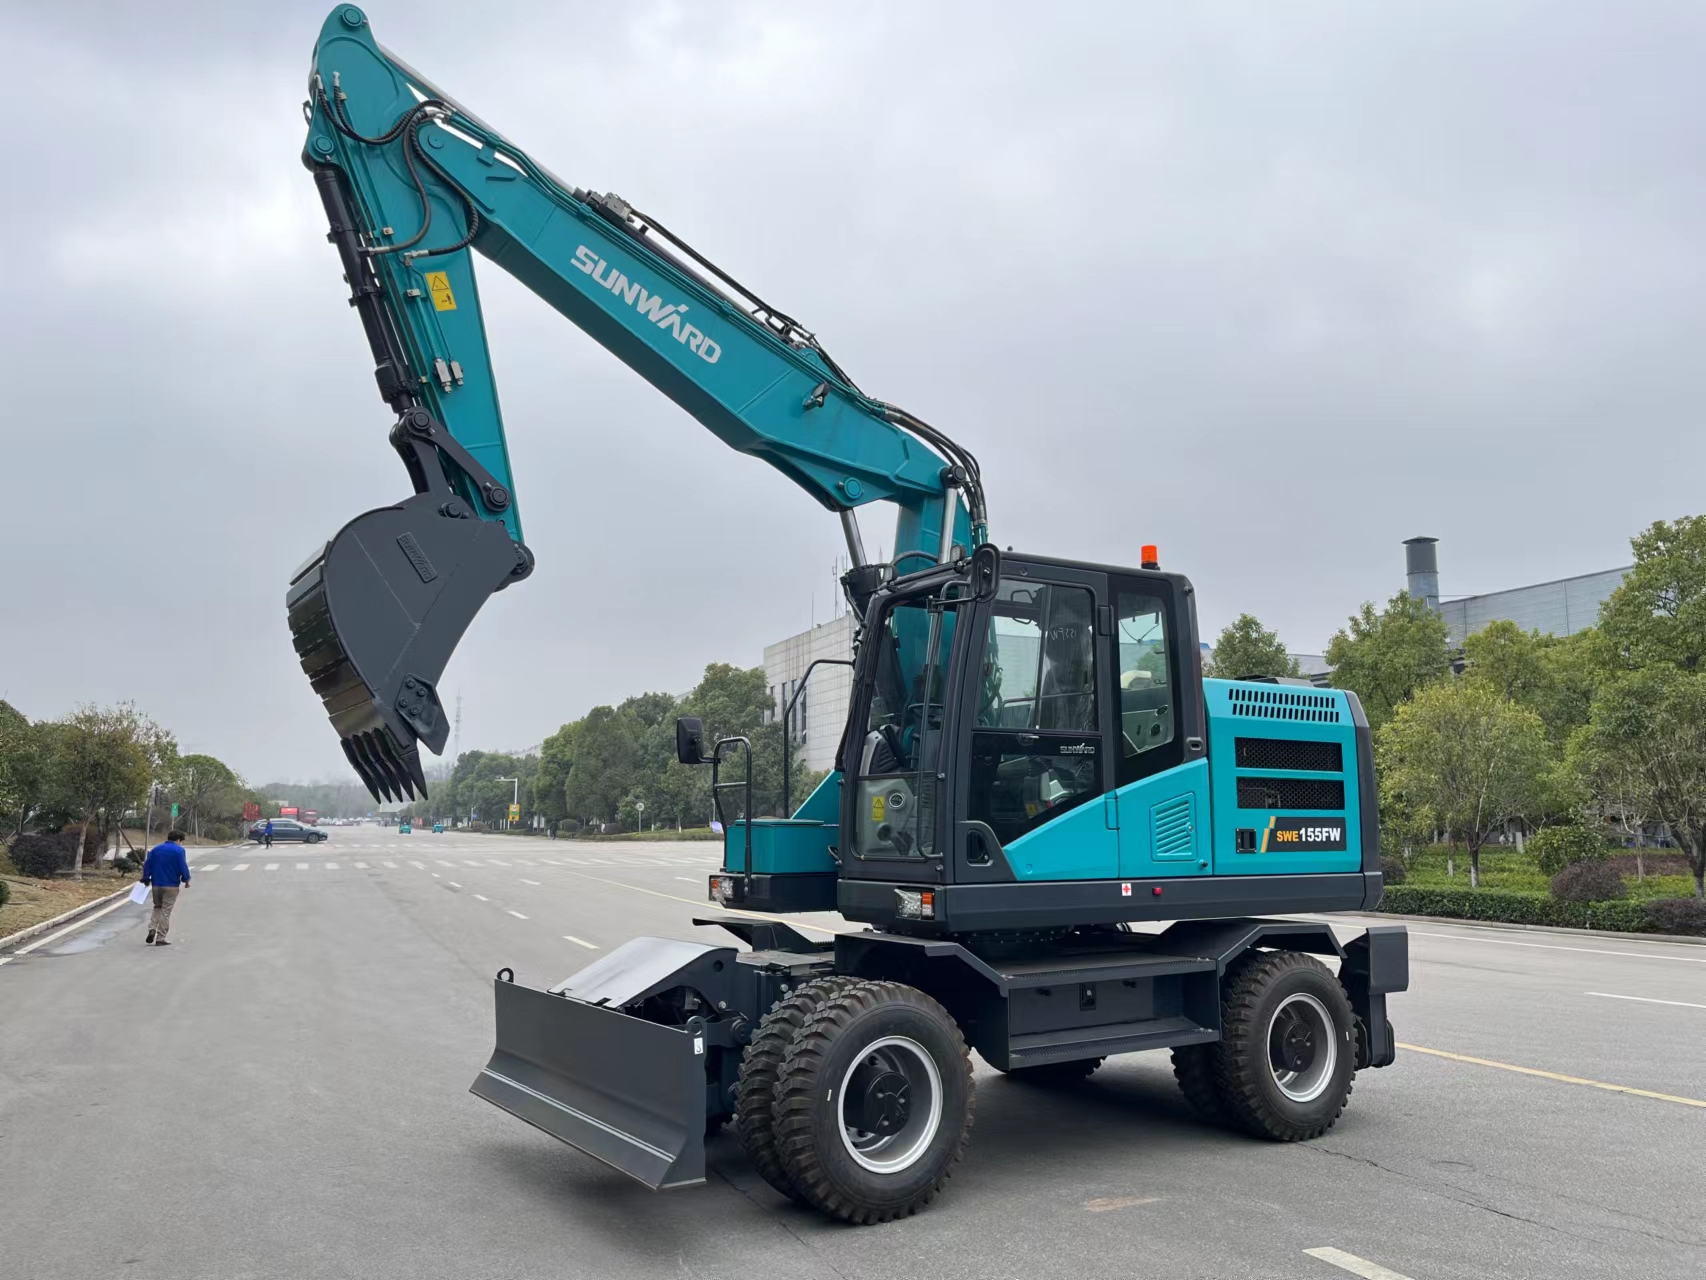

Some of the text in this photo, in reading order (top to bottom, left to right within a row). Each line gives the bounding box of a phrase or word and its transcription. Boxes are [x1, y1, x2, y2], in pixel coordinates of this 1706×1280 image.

[570, 244, 722, 364] SUNWARD
[398, 534, 434, 581] SUNWARD
[1060, 742, 1095, 754] SUNWARD
